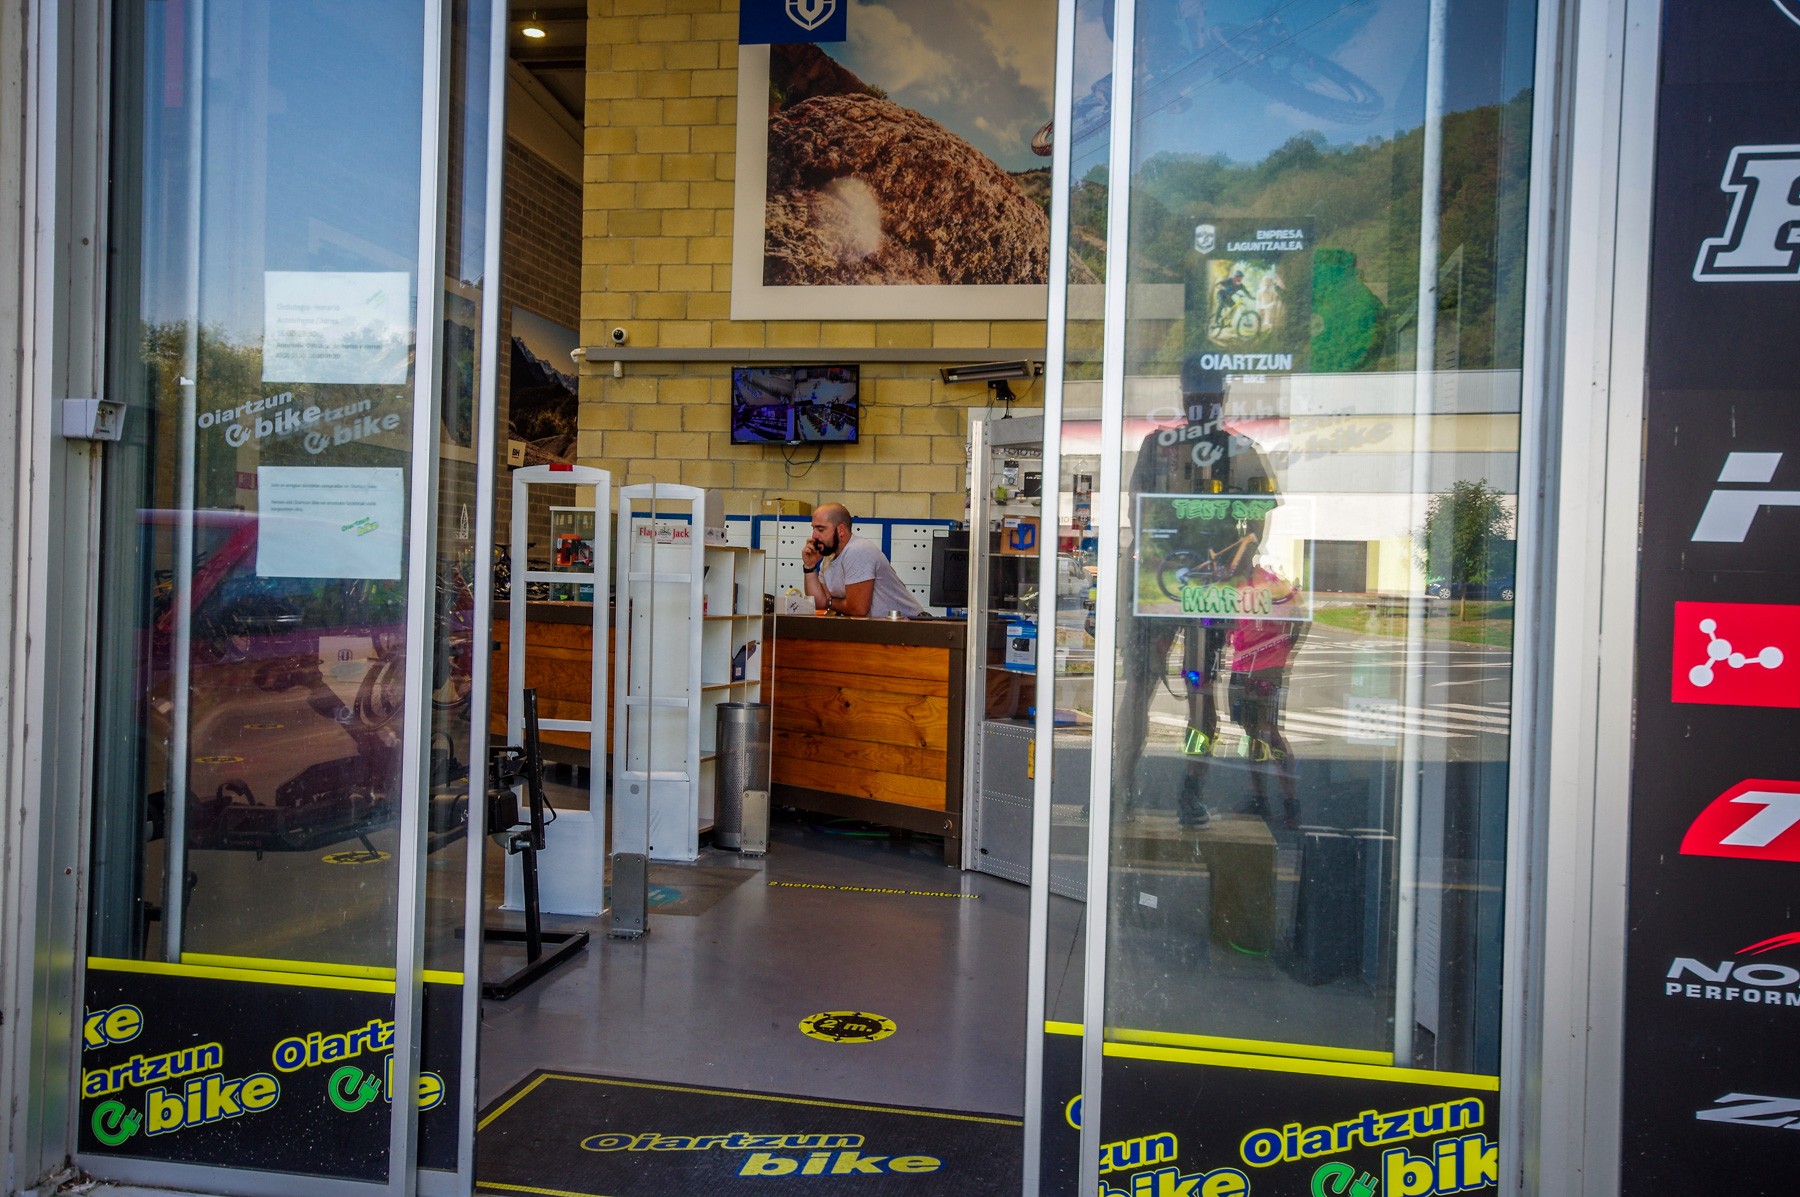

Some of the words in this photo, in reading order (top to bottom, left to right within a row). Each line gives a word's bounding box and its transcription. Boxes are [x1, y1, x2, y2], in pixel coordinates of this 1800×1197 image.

[1227, 240, 1303, 252] LAGUNTZAILEA
[1200, 354, 1293, 370] OIARTZUN
[198, 391, 292, 429] Oiartzun
[254, 405, 321, 439] bike
[333, 412, 400, 446] bike
[672, 528, 690, 539] Jack
[1181, 585, 1272, 615] MARIN
[909, 890, 980, 900] mantendu
[1666, 957, 1800, 987] NO
[1665, 982, 1800, 1007] PERFORM
[84, 1004, 143, 1050] ke
[820, 1019, 838, 1029] 2
[843, 1022, 873, 1033] m.
[82, 1042, 222, 1100] artzun
[145, 1072, 280, 1137] bike
[580, 1132, 865, 1151] Oiartzun
[1240, 1097, 1484, 1168] Oiartzun
[738, 1151, 944, 1177] bike
[1382, 1133, 1499, 1197] bik
